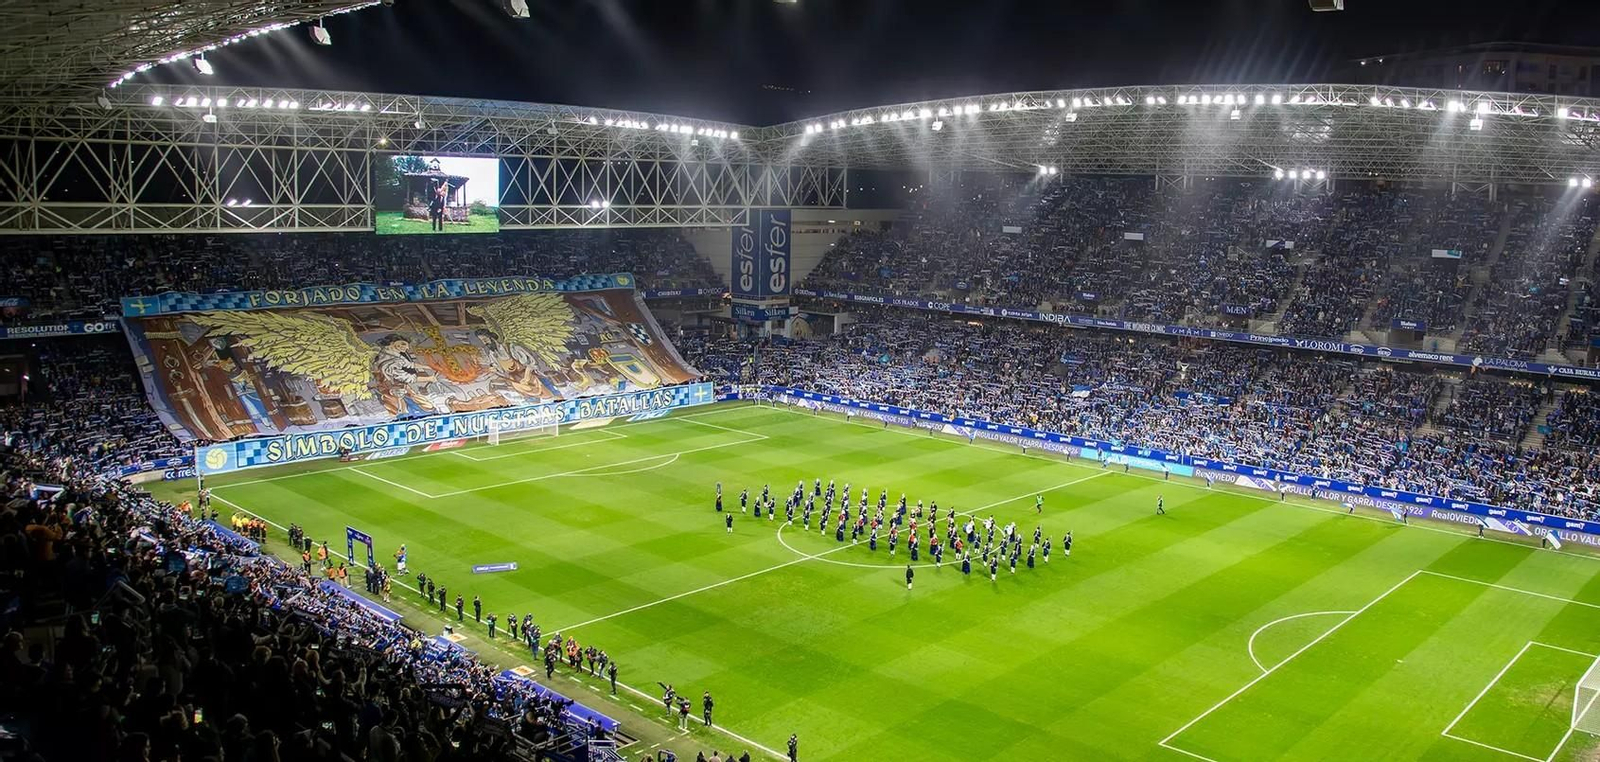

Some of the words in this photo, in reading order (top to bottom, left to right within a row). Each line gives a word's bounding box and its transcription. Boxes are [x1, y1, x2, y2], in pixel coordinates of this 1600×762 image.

[764, 213, 787, 293] esfer
[736, 227, 754, 292] esfer
[249, 286, 361, 307] FORJADO
[377, 287, 405, 301] EN
[421, 283, 451, 299] LA
[464, 278, 555, 296] LEYENDA
[1304, 340, 1344, 352] LOROMI
[267, 428, 389, 462] SÍMBOLO
[406, 421, 438, 443] DE
[453, 405, 565, 437] NUESTRAS
[580, 389, 673, 418] BATALLAS
[1315, 489, 1340, 501] VALOR
[1347, 496, 1374, 508] GARRA
[1416, 496, 1433, 505] gam7
[1452, 502, 1469, 511] gam7
[1488, 509, 1506, 517] gam7
[1526, 515, 1545, 524] gam7
[1566, 522, 1585, 530] gam7
